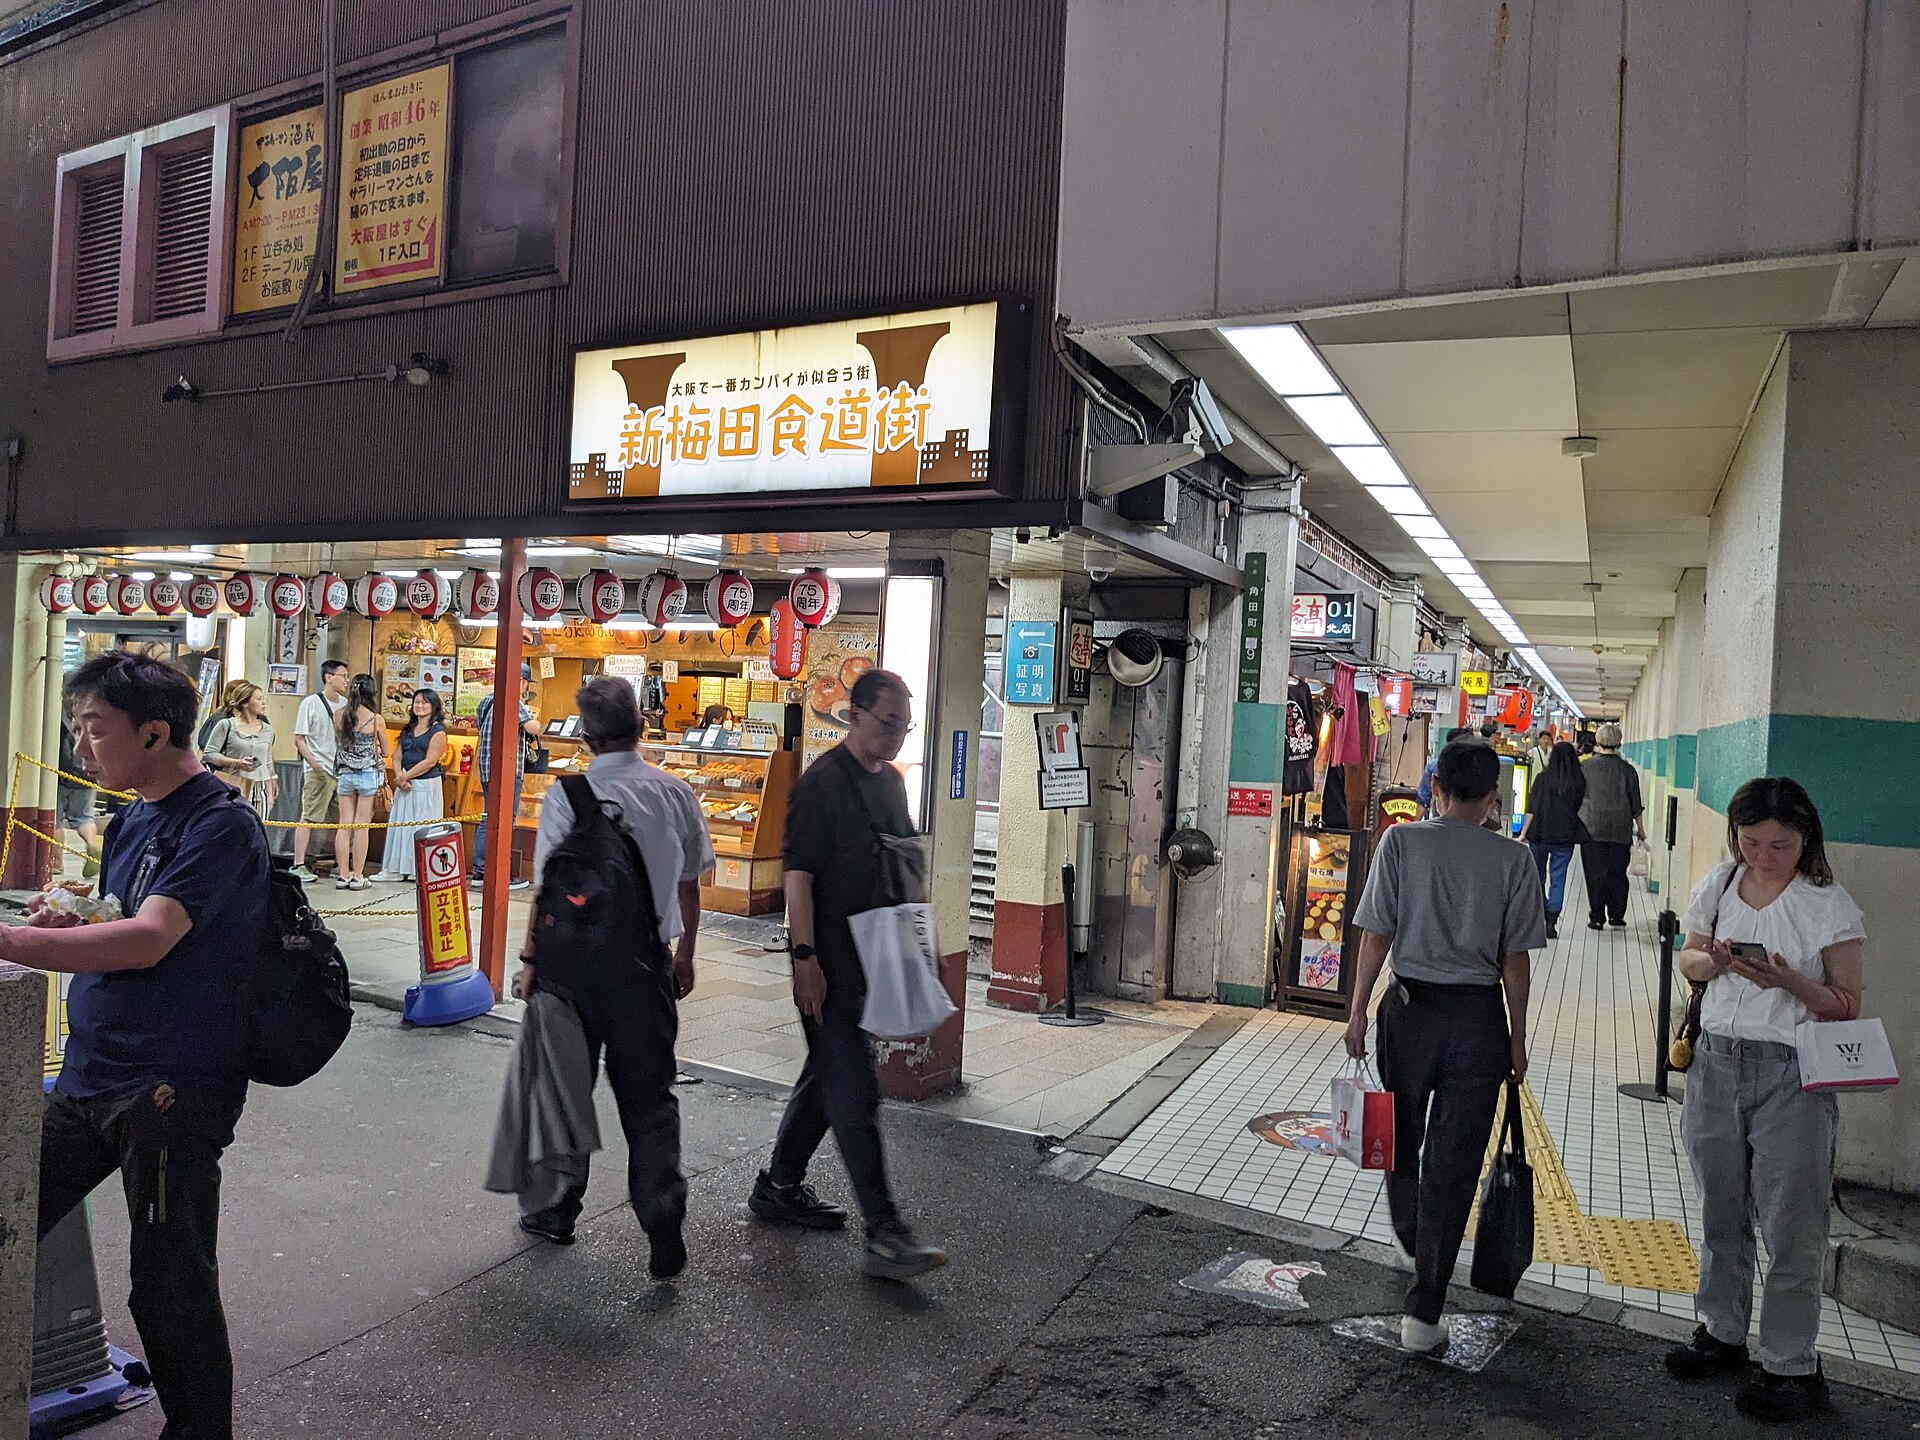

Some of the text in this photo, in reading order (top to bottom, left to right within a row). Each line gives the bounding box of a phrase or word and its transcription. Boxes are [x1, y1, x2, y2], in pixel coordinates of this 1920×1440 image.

[373, 81, 423, 104] ほんまおおきに
[378, 112, 401, 131] 昭和
[360, 133, 427, 162] 初出勤の日から
[354, 151, 431, 183] 定年退職の日まで
[350, 170, 434, 200] サラリーマンさんを
[351, 216, 427, 246] 大阪屋はすぐ
[243, 236, 303, 262] 1F 立呑み処
[242, 267, 257, 283] 2F
[261, 281, 291, 299] お座敷
[670, 364, 870, 398] 大阪で一番カンパイが似合う街
[618, 384, 932, 466] 新梅田食道街
[159, 584, 173, 593] 75
[197, 587, 212, 596] 75
[228, 582, 242, 592] 75
[280, 587, 297, 596] 75
[333, 585, 347, 595] 75
[378, 586, 393, 596] 75
[411, 582, 428, 592] 75
[482, 586, 497, 597] 75
[541, 582, 558, 593] 75
[603, 587, 619, 597] 75
[730, 587, 748, 599] 75
[800, 584, 817, 596] 75
[278, 596, 298, 607] 周年
[411, 593, 431, 605] 周年
[539, 593, 559, 604] 周年
[599, 597, 621, 609] 周年
[796, 597, 820, 610] 周年
[726, 600, 749, 613] 周年
[1248, 586, 1259, 628] 角田町
[1327, 601, 1352, 617] 01
[1326, 623, 1351, 634] 北店
[1016, 664, 1044, 678] 証明
[1073, 668, 1085, 682] 01
[1015, 682, 1043, 697] 写真
[1230, 790, 1271, 801] 送水口
[437, 881, 448, 889] NOT
[451, 888, 462, 931] 関係者以外
[436, 892, 454, 952] 立入禁止
